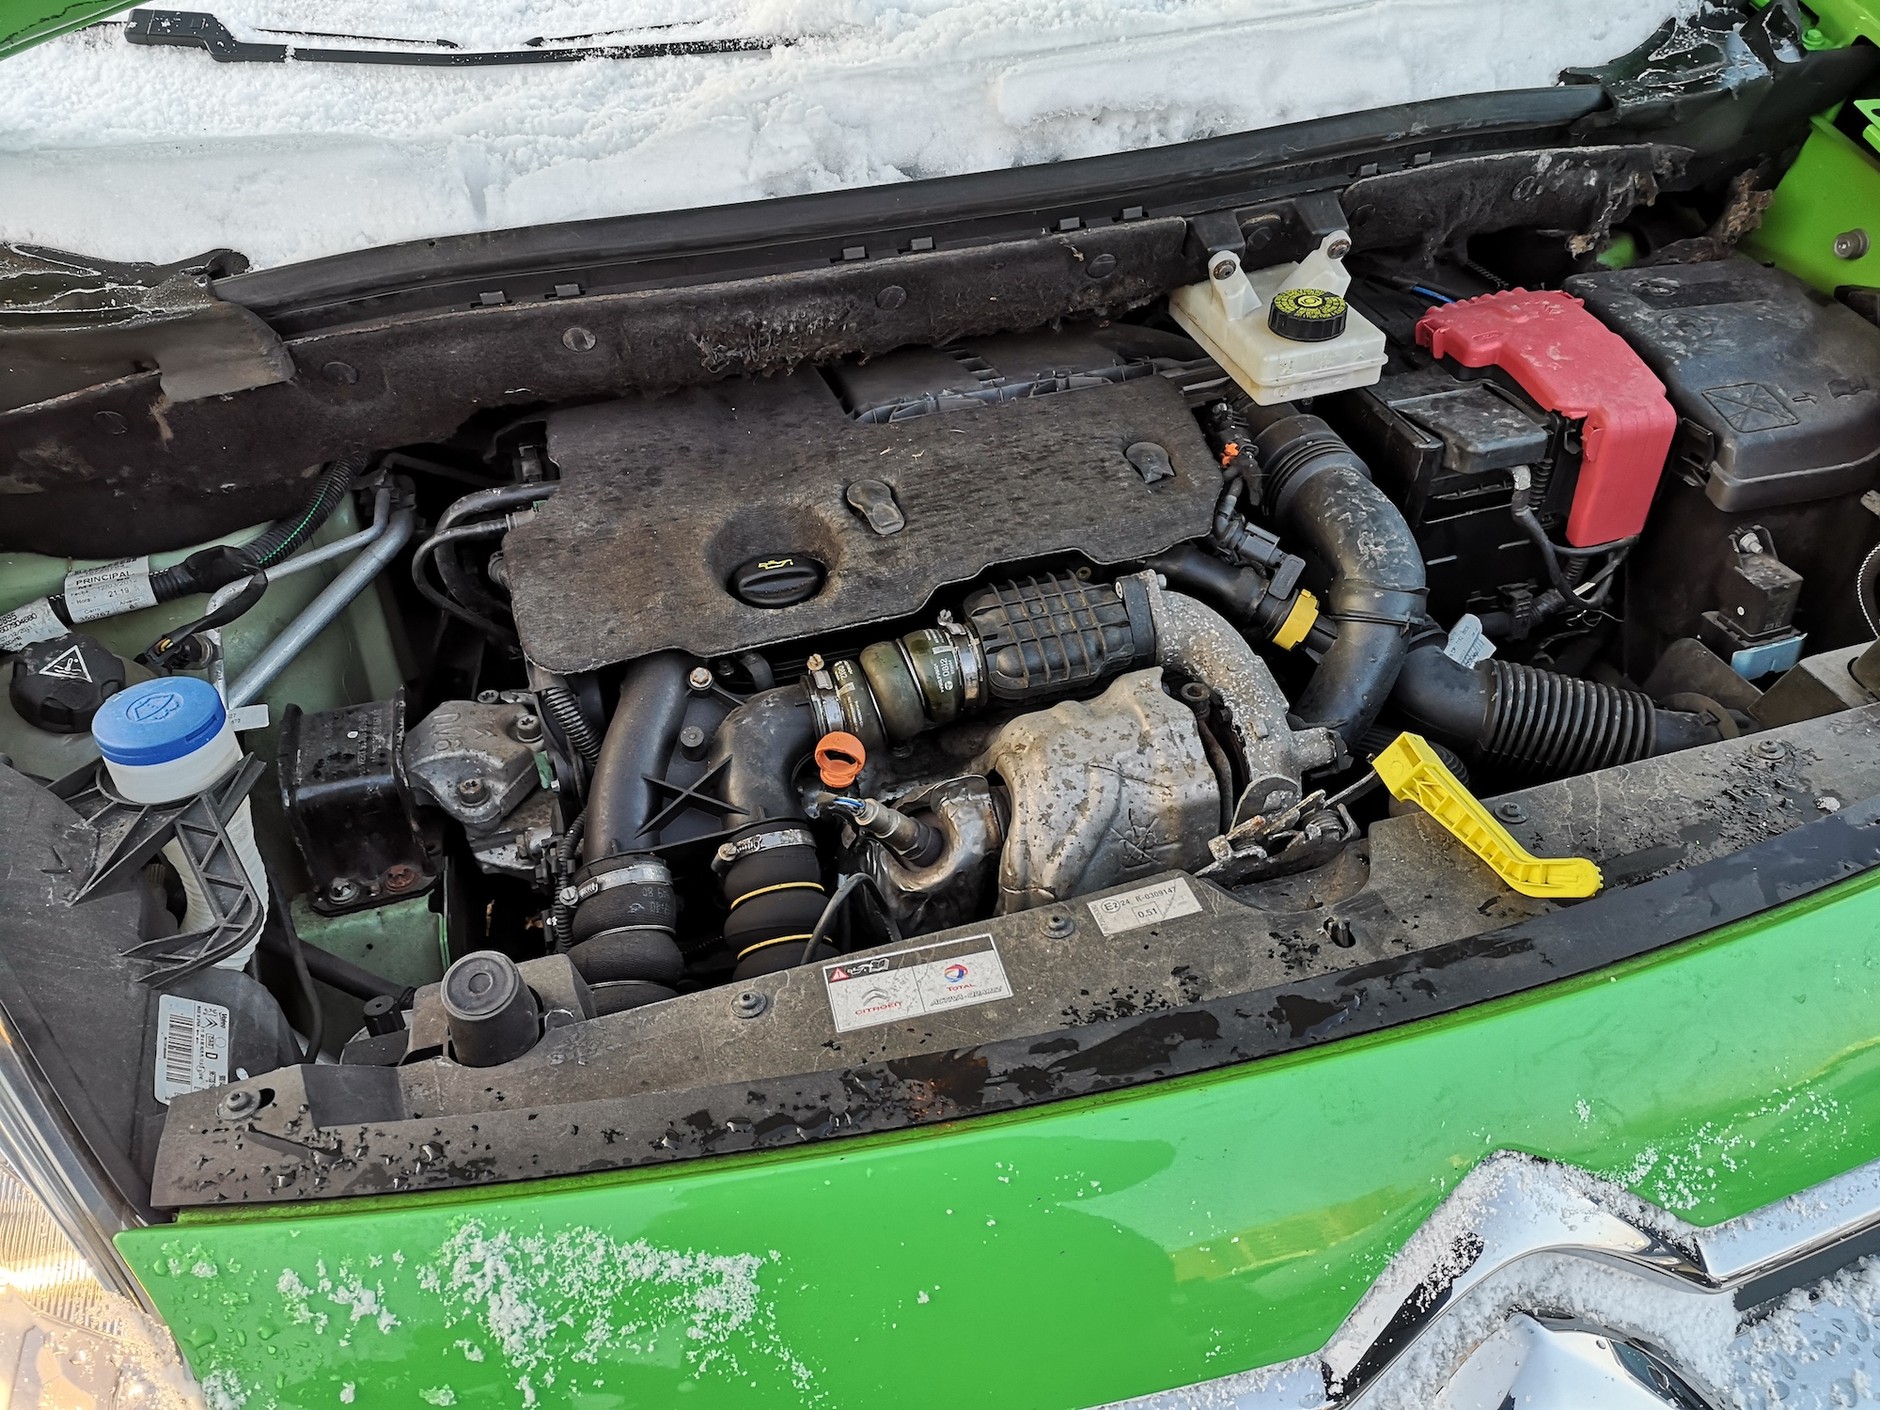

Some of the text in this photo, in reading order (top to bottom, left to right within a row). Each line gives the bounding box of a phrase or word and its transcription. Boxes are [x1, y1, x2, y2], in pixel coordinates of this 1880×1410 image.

[76, 570, 130, 586] PRINCIPAL
[1137, 907, 1158, 919] 0.51
[946, 983, 976, 992] TOTAL
[205, 1052, 218, 1060] D
